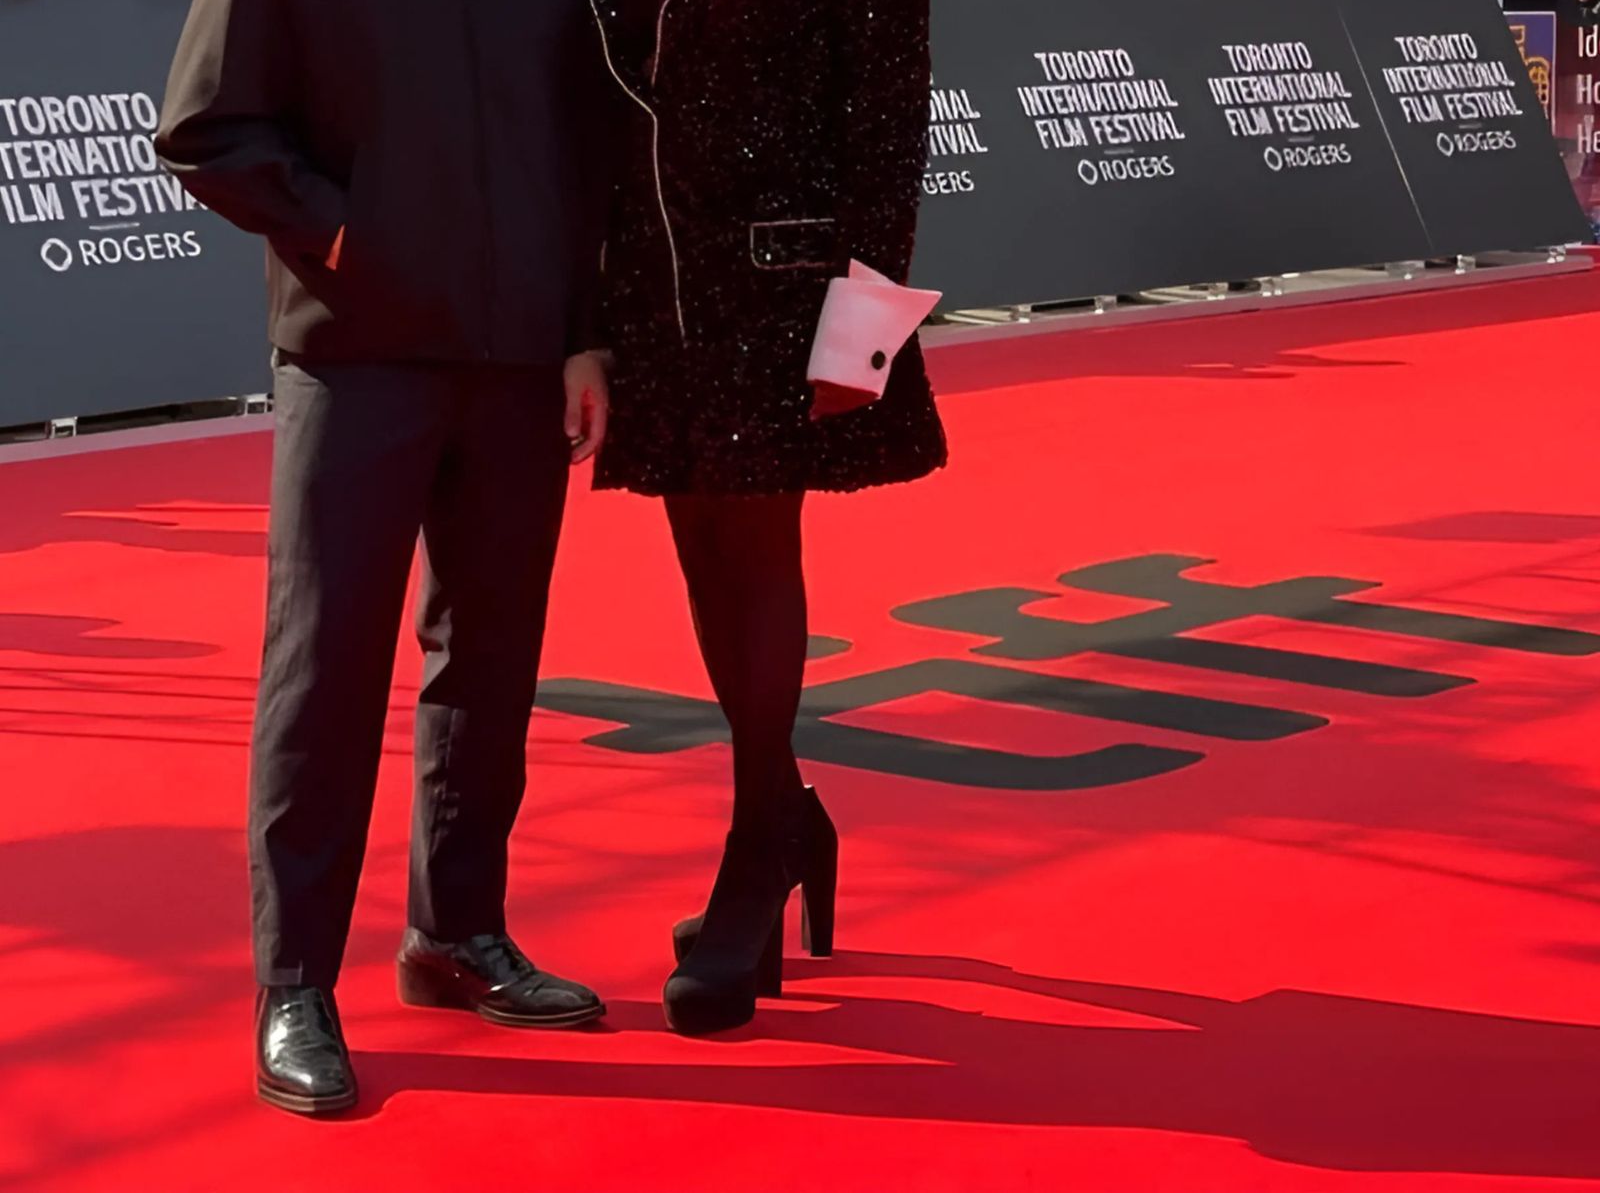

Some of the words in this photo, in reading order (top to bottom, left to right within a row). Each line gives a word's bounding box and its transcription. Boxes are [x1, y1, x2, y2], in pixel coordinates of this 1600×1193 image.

[1222, 42, 1312, 73] TORONTO
[1394, 33, 1477, 62] TORONTO
[1034, 48, 1134, 81] TORONTO
[1382, 61, 1515, 94] INTERNATIONAL
[1017, 79, 1178, 117] INTERNATIONAL
[1208, 71, 1352, 105] INTERNATIONAL
[0, 92, 157, 136] TORONTO
[1225, 107, 1273, 136] FILM
[1273, 101, 1360, 133] FESTIVAL
[1400, 94, 1444, 123] FILM
[1444, 89, 1523, 120] FESTIVAL
[1034, 118, 1088, 149] FILM
[1089, 111, 1186, 145] FESTIVAL
[1454, 130, 1516, 152] ROGERS
[1099, 155, 1175, 181] ROGERS
[1283, 143, 1351, 167] ROGERS
[922, 170, 975, 195] GERS
[0, 182, 65, 224] ILM
[78, 231, 201, 266] ROGERS
